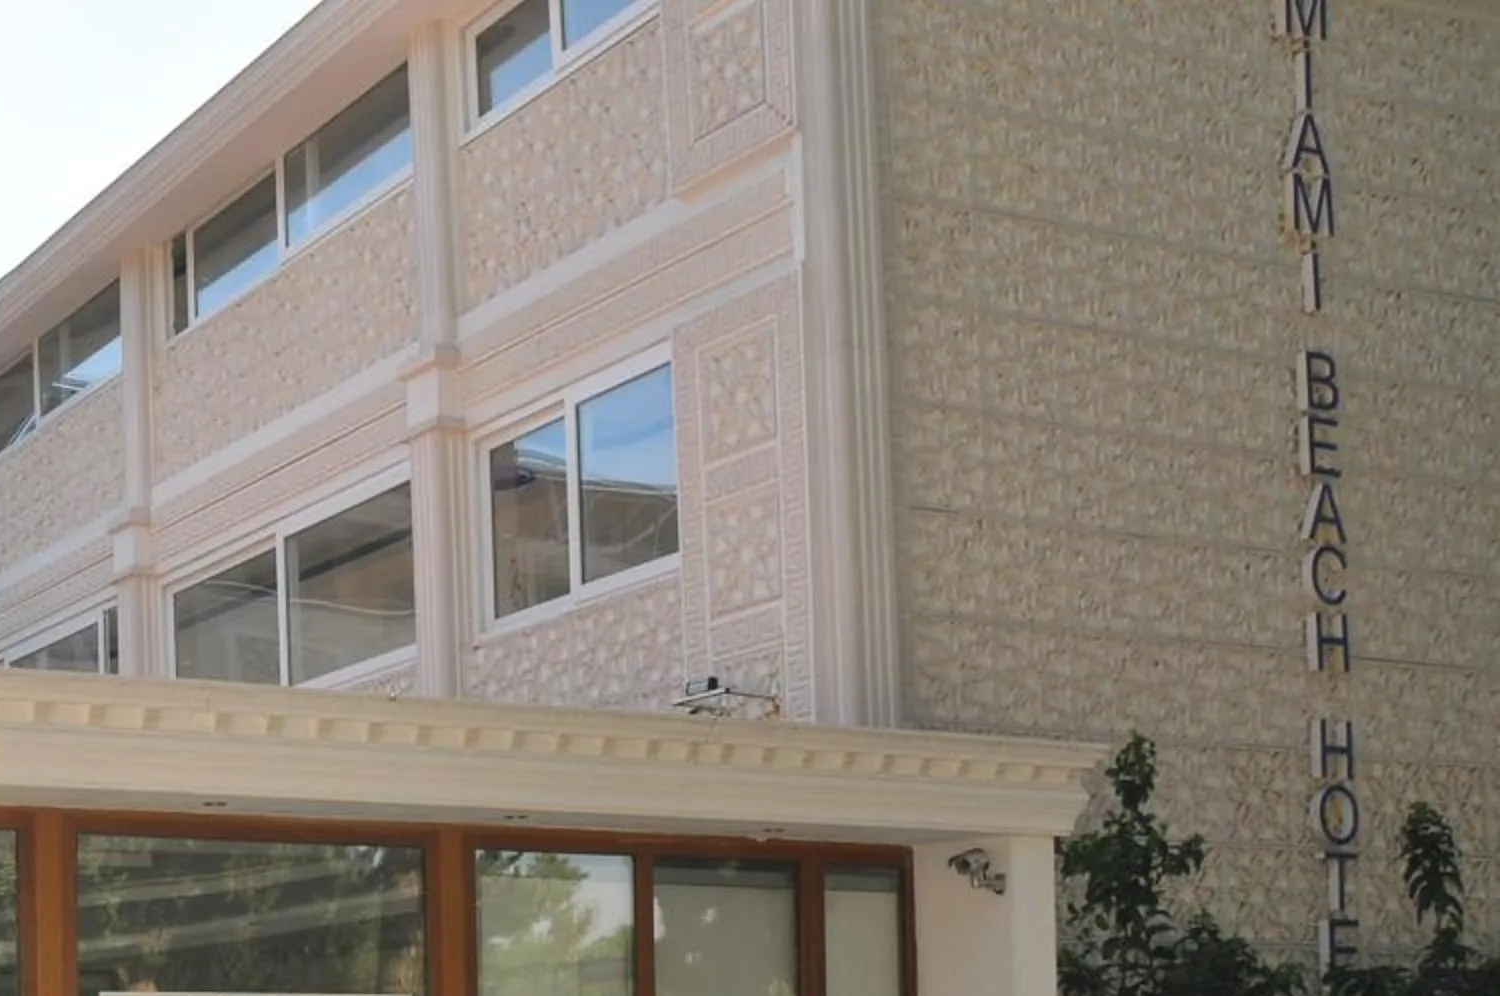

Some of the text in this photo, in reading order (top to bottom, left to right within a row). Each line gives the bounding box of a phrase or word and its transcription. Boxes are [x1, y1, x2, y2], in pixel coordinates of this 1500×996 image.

[1282, 0, 1360, 968] MIAMI BEACH HOTE
